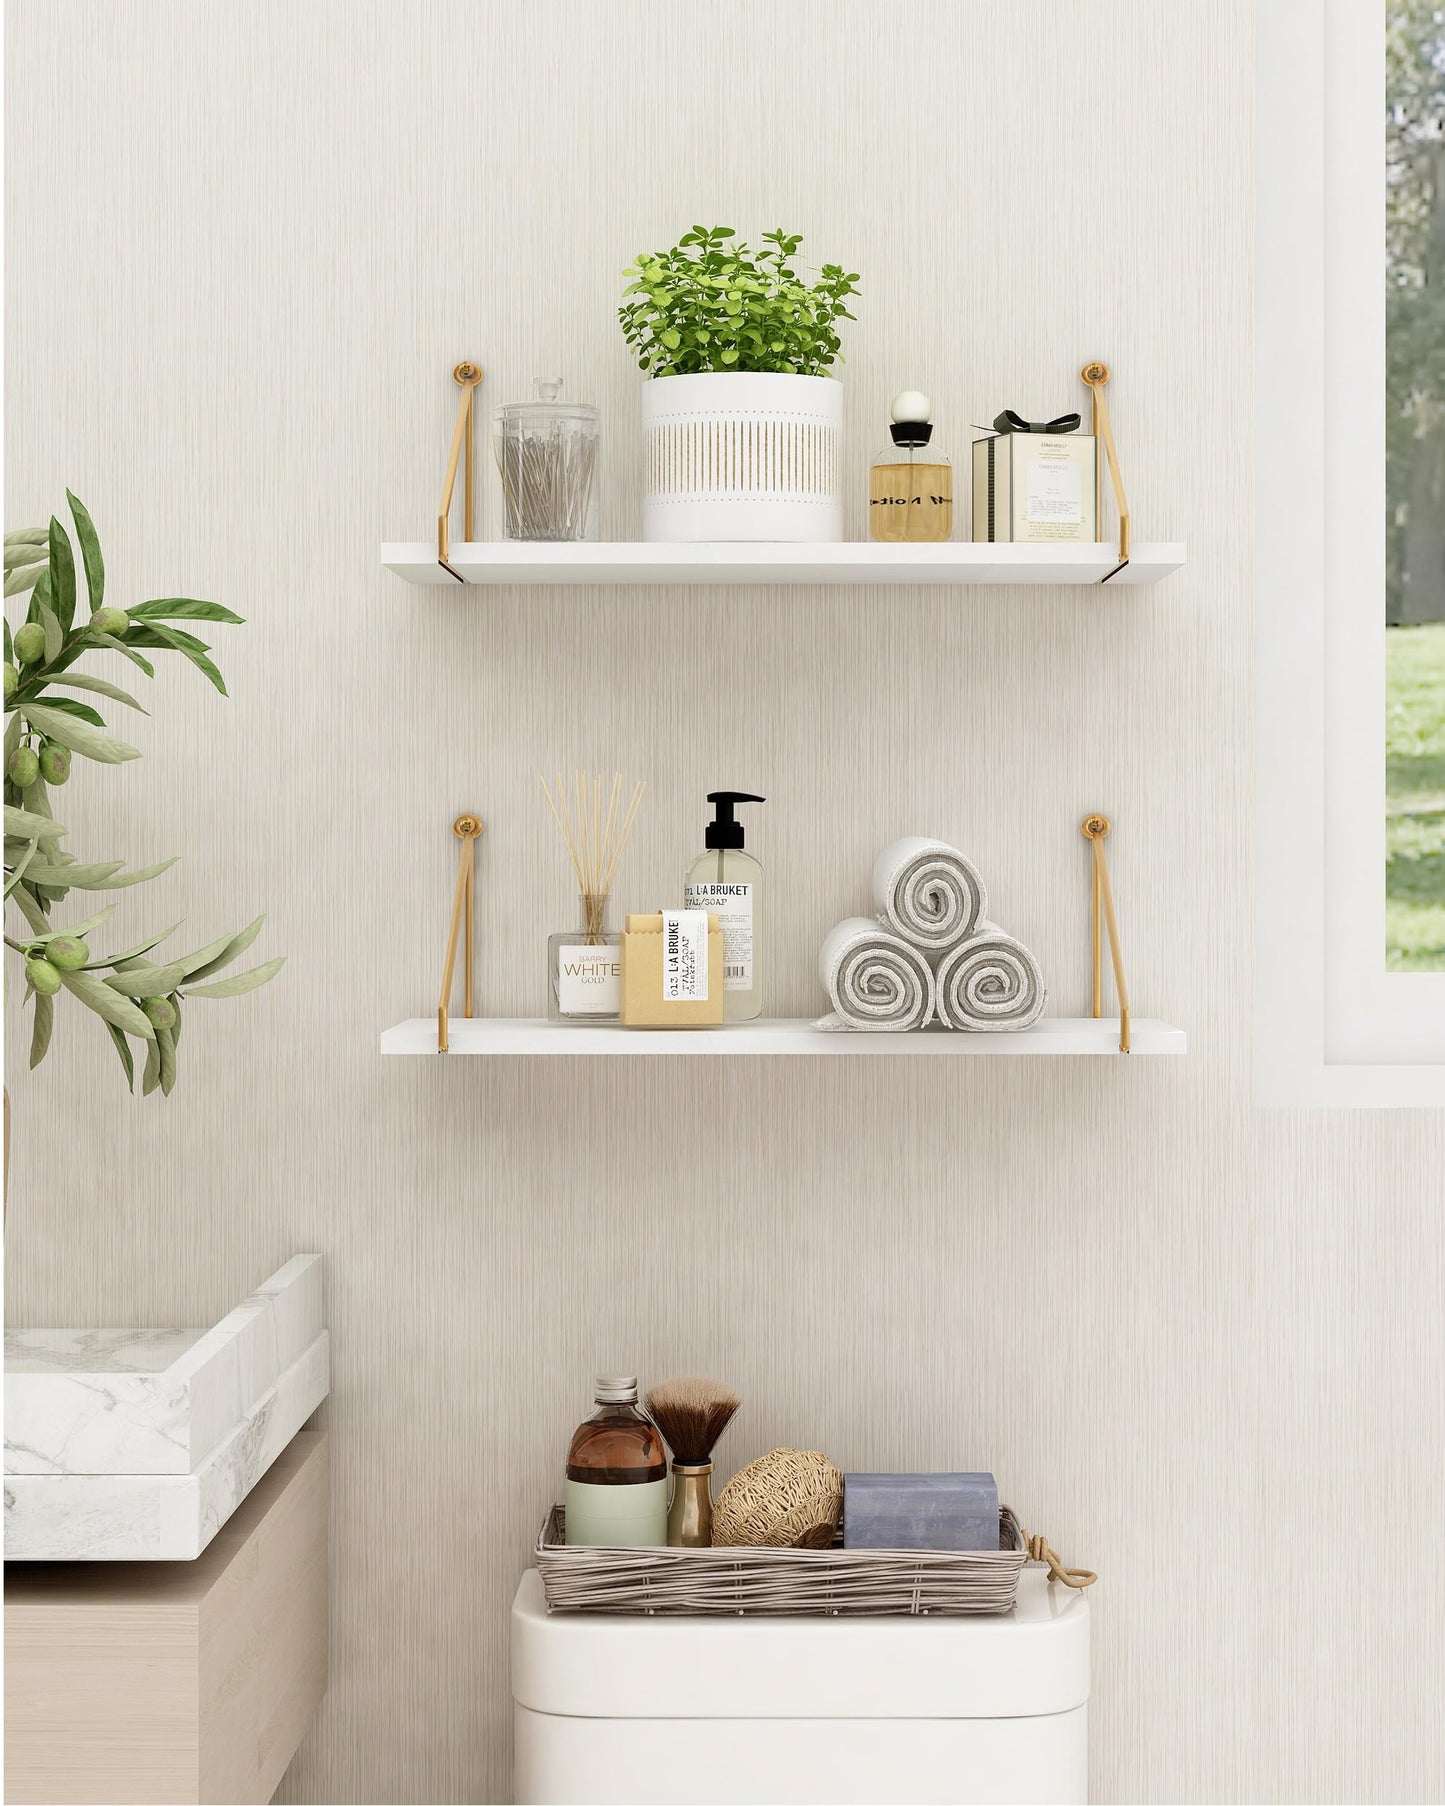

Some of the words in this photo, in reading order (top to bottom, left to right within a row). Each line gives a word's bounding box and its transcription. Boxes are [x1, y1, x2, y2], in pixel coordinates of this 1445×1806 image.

[696, 885, 708, 896] L:A
[710, 885, 749, 896] BRUKET
[564, 963, 621, 976] WHITE
[668, 957, 679, 972] L:A
[581, 976, 605, 984] GOLD
[670, 976, 679, 997] 013
